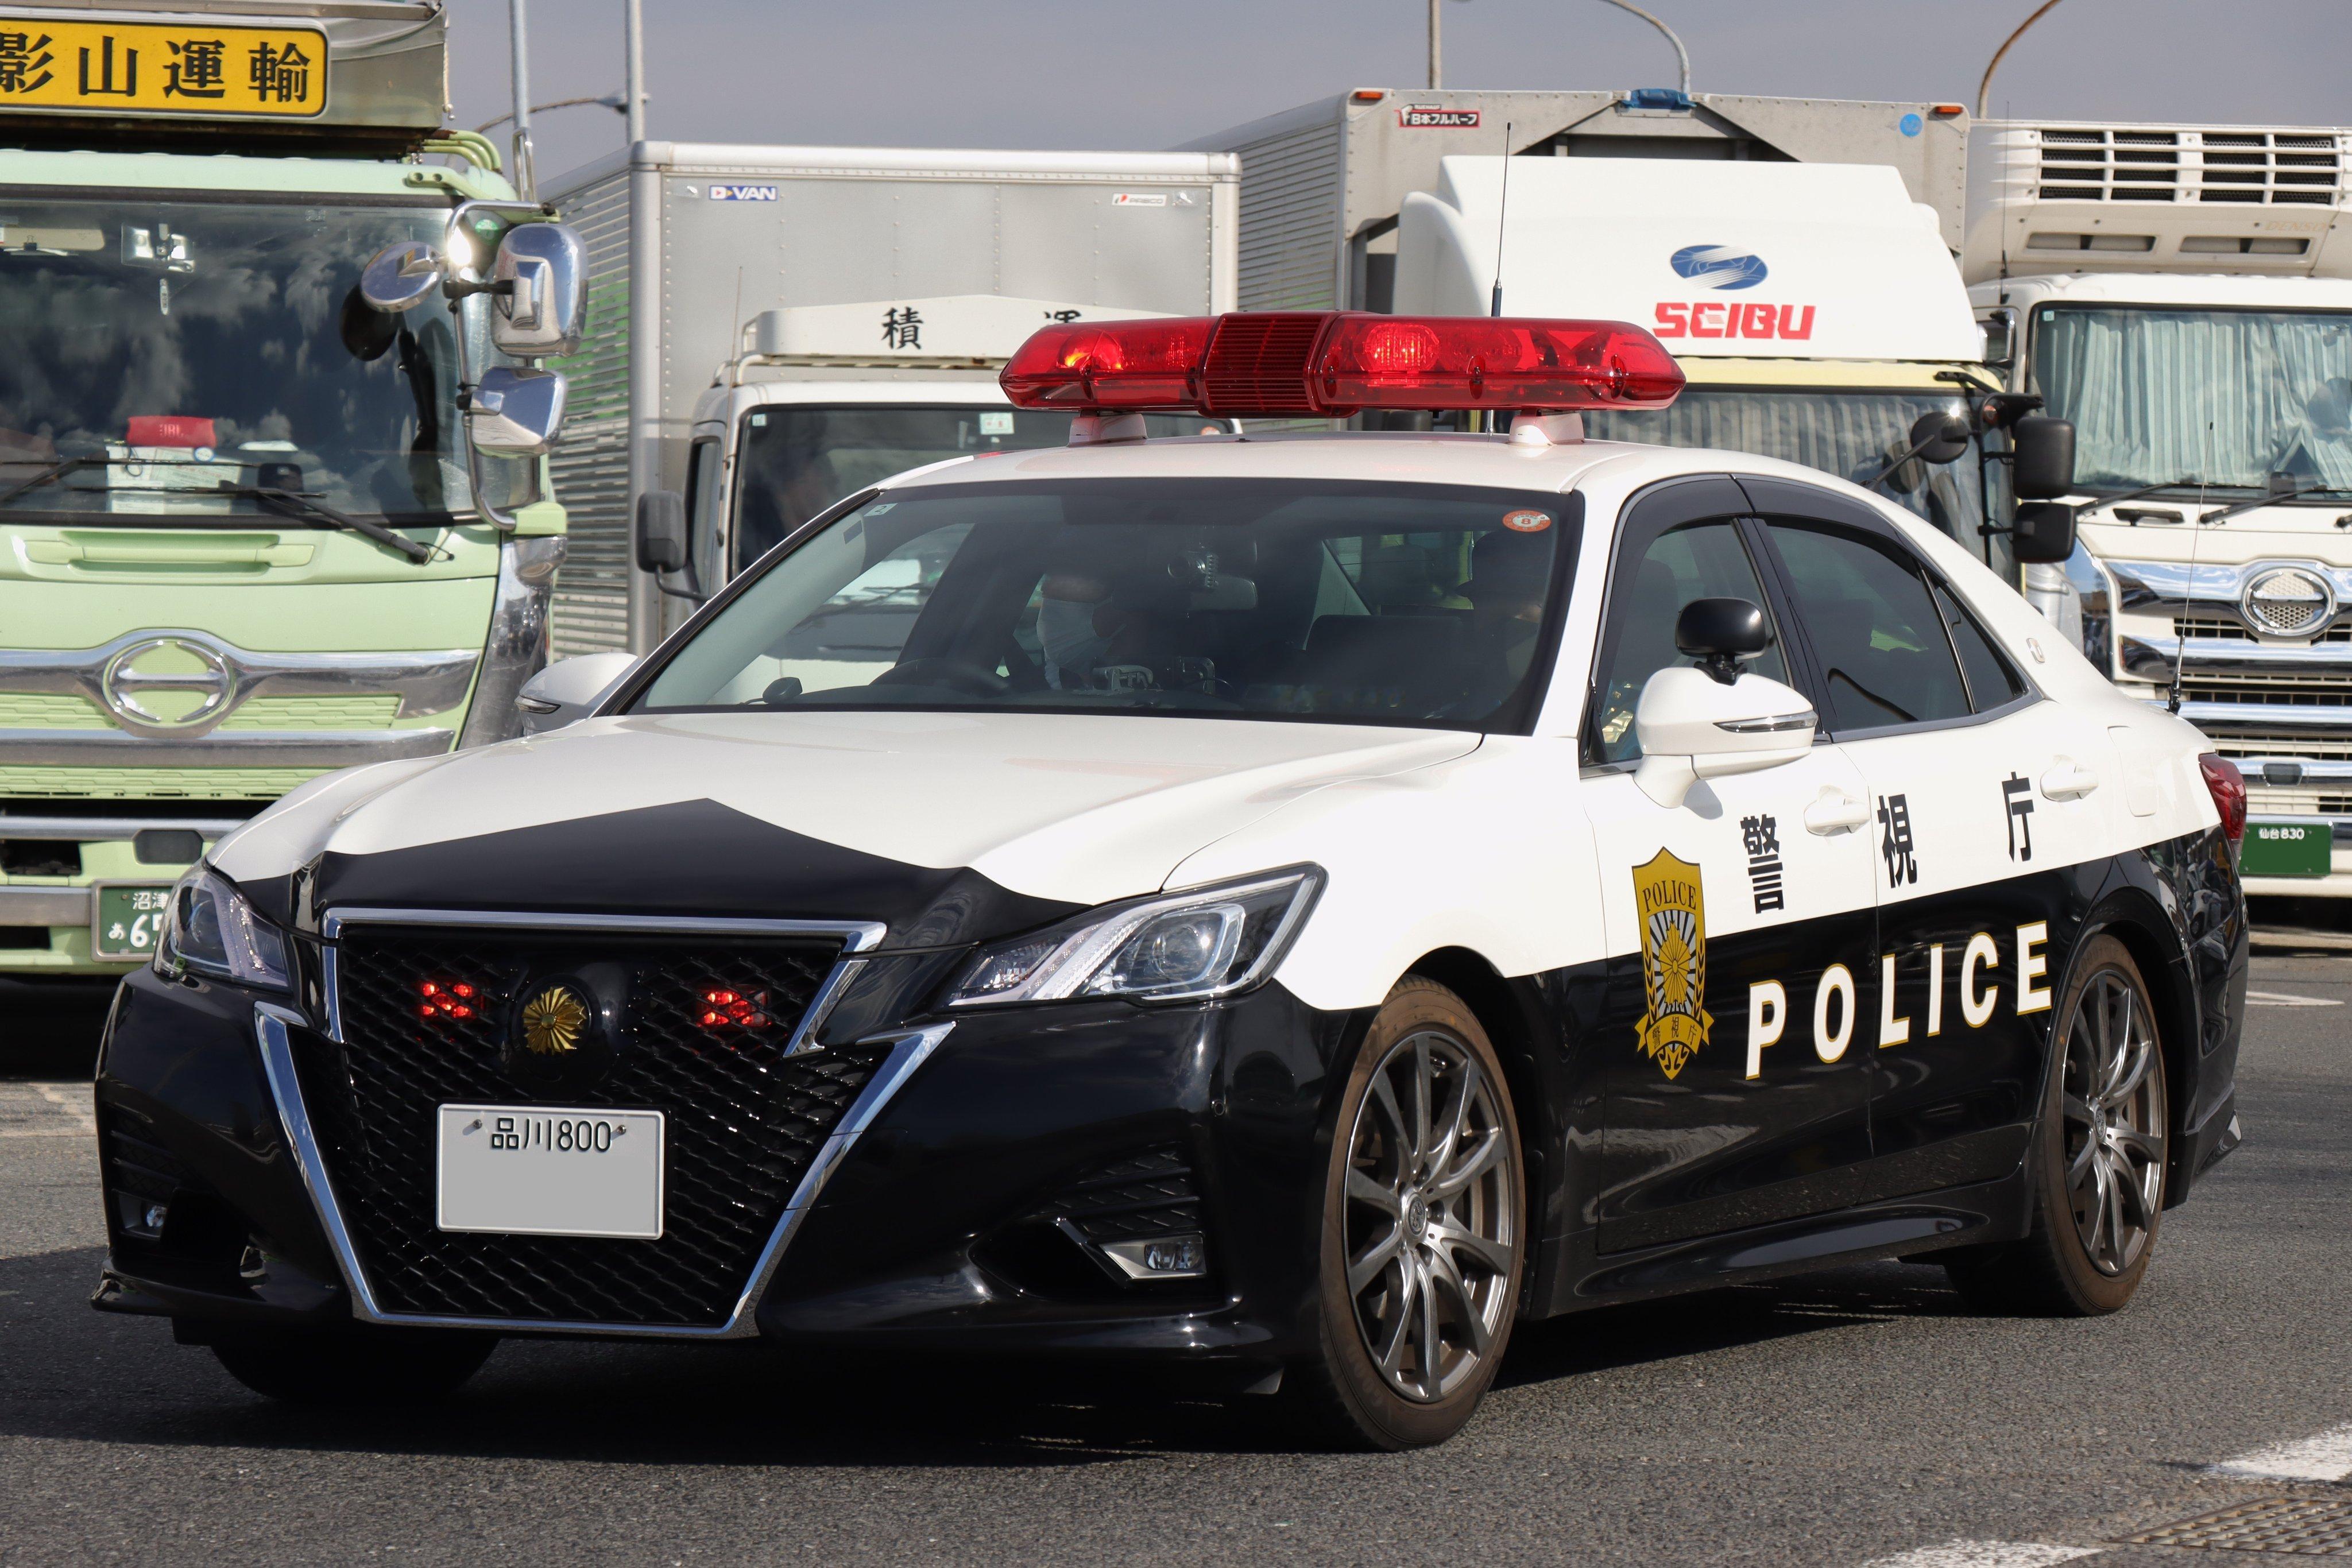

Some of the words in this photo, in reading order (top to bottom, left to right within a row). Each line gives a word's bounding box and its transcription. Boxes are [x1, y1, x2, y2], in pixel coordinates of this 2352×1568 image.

[0, 32, 311, 103] 影山運輸
[1410, 113, 1477, 125] 日本フルハーフ
[1653, 302, 1816, 340] SEIBU
[1740, 772, 2033, 914] 警視庁
[1642, 879, 1697, 913] POLICE
[108, 922, 126, 940] あ
[1745, 920, 2053, 1081] POLICE
[1652, 1016, 1697, 1050] 警視庁
